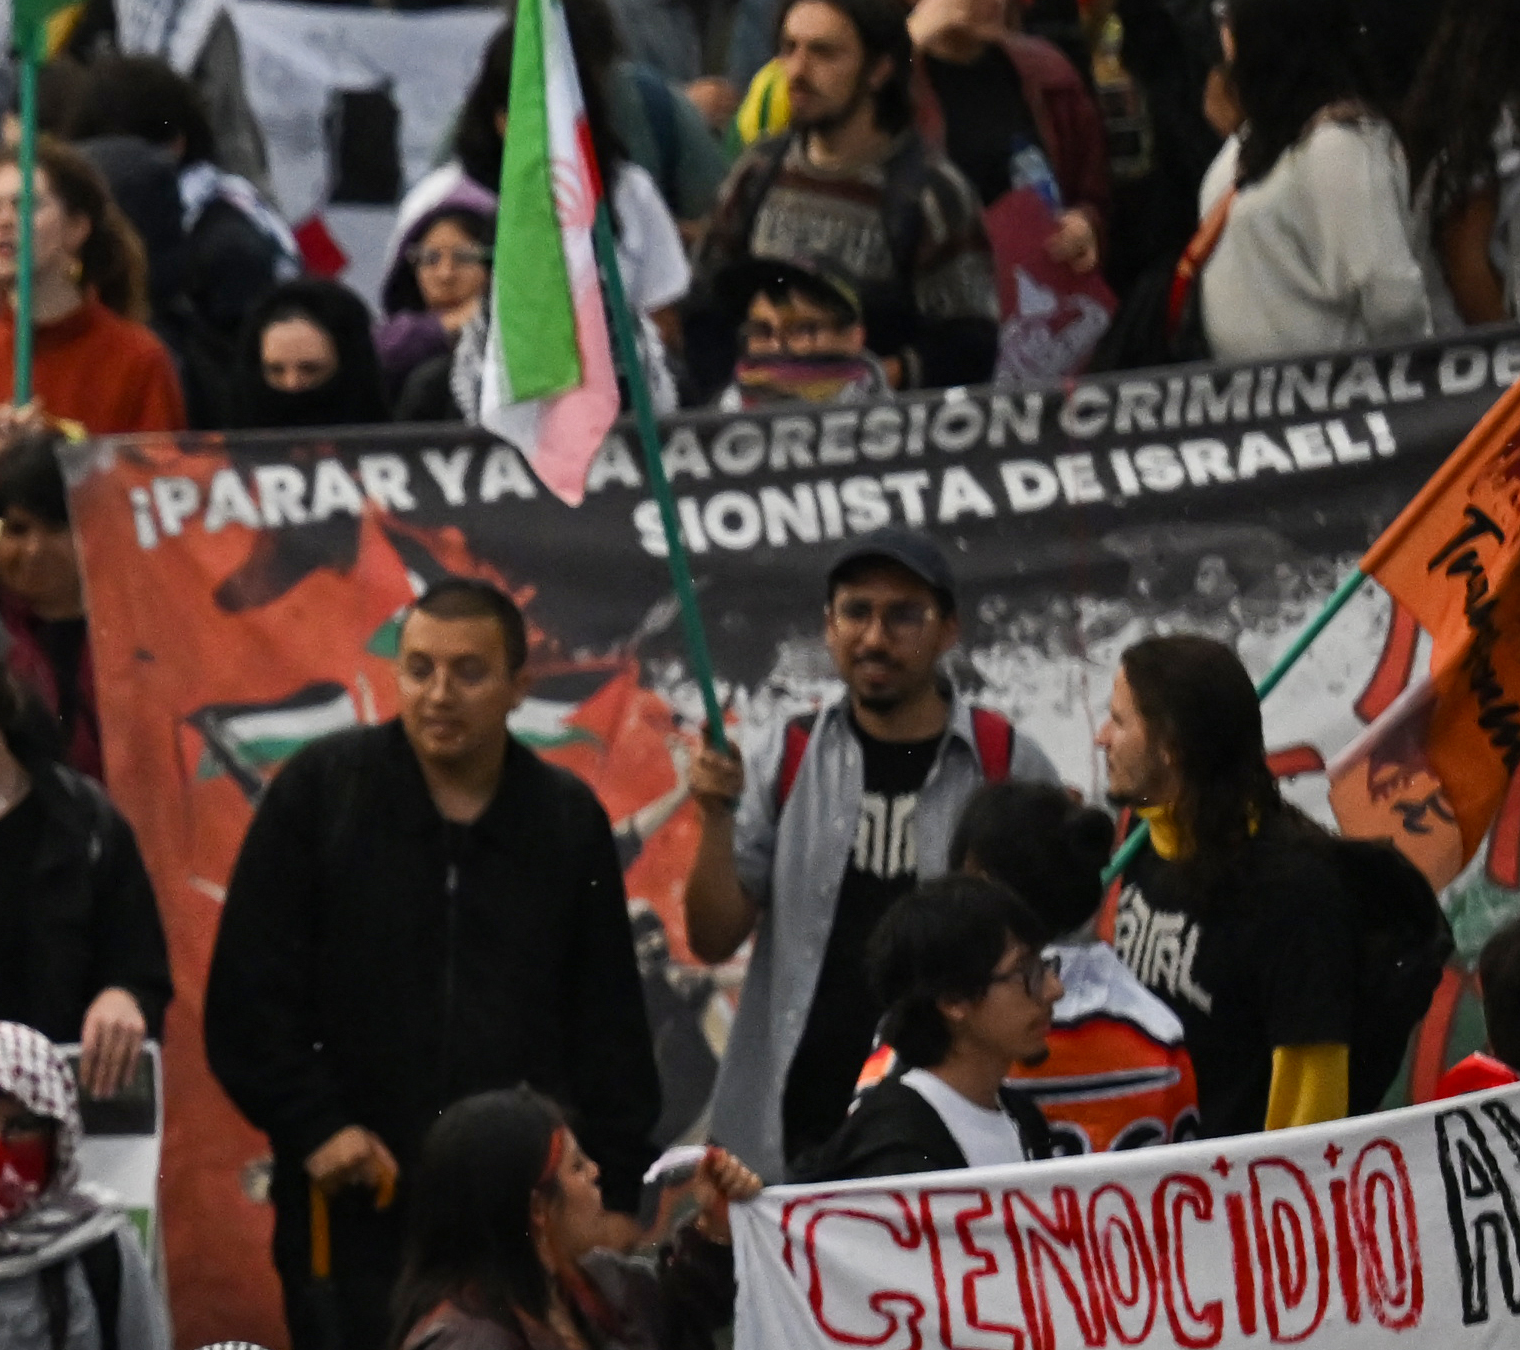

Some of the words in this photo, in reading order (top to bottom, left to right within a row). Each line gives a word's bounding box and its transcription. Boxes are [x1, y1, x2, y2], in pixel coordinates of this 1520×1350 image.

[129, 452, 416, 549] ¡PARAR
[420, 446, 538, 507] YA
[662, 385, 1043, 481] AGRESIÓN
[1057, 354, 1426, 440] CRIMINAL
[633, 465, 998, 558] SIONISTA
[999, 451, 1104, 514] DE
[1109, 409, 1397, 500] ISRAEL!
